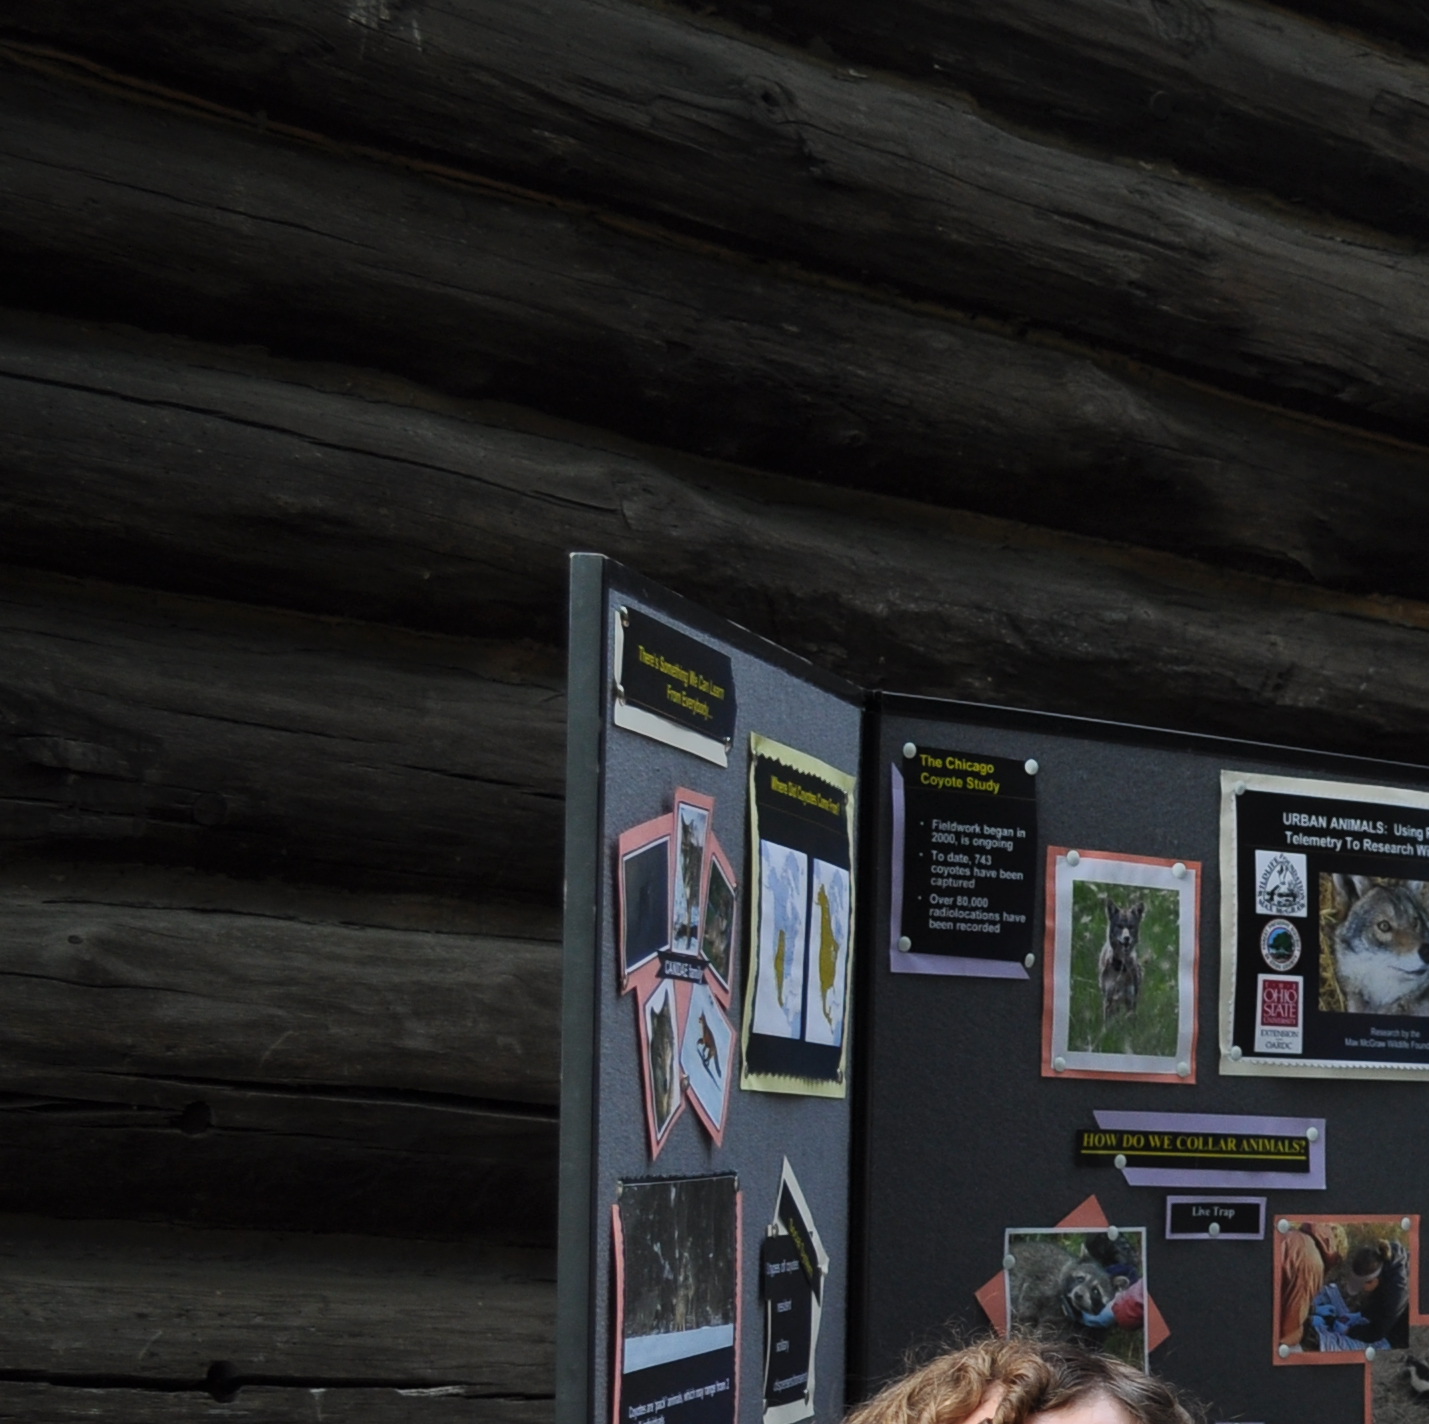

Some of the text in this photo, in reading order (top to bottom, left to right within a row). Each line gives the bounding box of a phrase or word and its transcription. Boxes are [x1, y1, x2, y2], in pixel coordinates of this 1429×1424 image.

[919, 754, 994, 775] The Chicago
[920, 772, 1000, 794] Coyote Study
[932, 819, 1026, 838] Fieldwork began in
[1282, 812, 1327, 827] URBAN
[1329, 817, 1387, 833] ANIMALS:
[1393, 823, 1423, 840] Using
[931, 832, 1013, 851] 2000, is ongoing
[1284, 831, 1342, 851] Telemetry
[1344, 836, 1360, 850] To
[1362, 838, 1414, 854] Research
[931, 849, 991, 865] To date, 743
[930, 865, 1023, 880] coyotes have been
[930, 877, 975, 888] captured
[929, 893, 988, 907] Over 80,000
[928, 907, 1026, 923] radiolocations have
[928, 919, 1000, 933] been recorded
[1264, 988, 1297, 1003] OHIO
[1264, 1003, 1296, 1018] STATE
[1083, 1133, 1306, 1152] HOW DO WE COLLAR ANIMALS?
[1192, 1206, 1235, 1219] Live Trap
